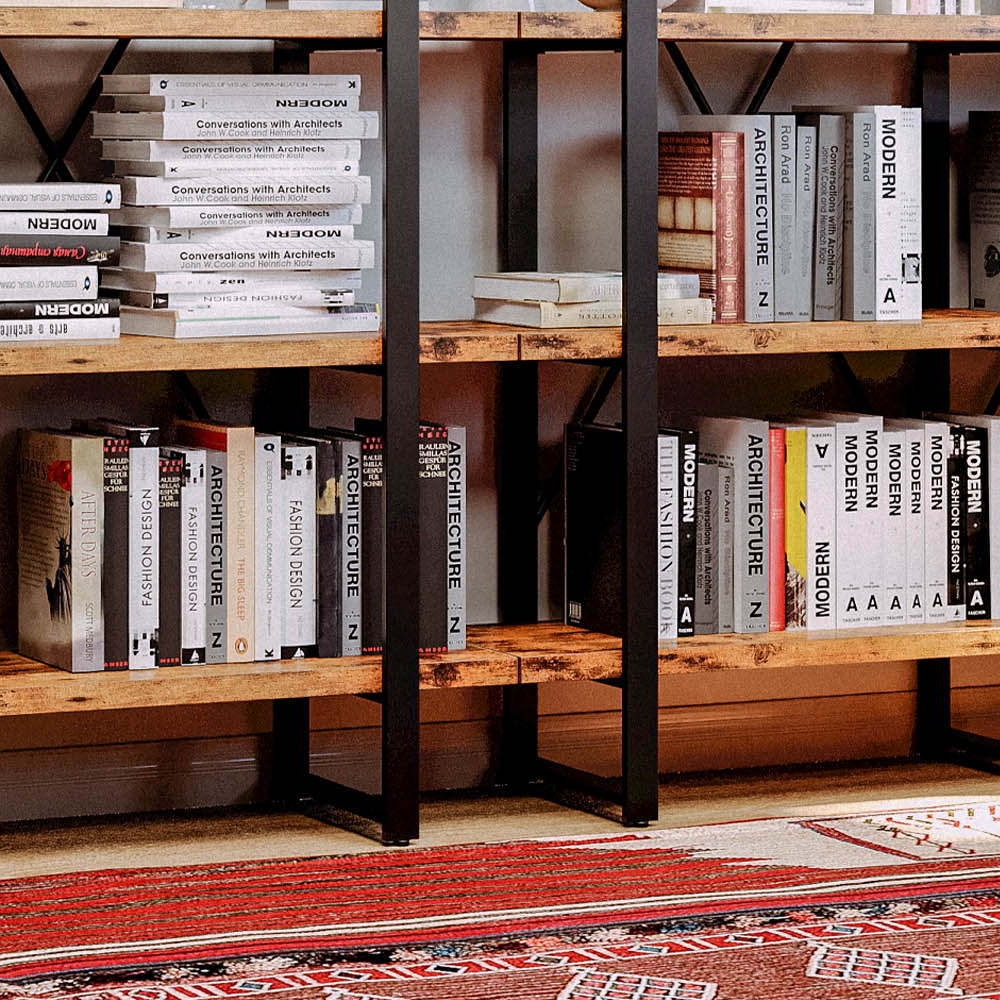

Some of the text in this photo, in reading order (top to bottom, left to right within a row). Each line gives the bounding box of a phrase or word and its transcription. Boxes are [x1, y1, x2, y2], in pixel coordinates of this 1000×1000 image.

[197, 120, 342, 129] Conversations with Architects
[197, 129, 216, 137] John
[250, 129, 266, 137] and
[276, 100, 348, 108] MODERN
[781, 125, 792, 184] Ron Arad
[863, 123, 871, 182] Ron Arad
[882, 119, 896, 199] MODERN
[28, 218, 97, 230] MODERN
[172, 185, 331, 195] Conversations with Architects
[754, 128, 768, 266] ARCHITECTURE
[180, 250, 336, 261] Conversations with Architects
[266, 230, 341, 238] MODERN
[35, 304, 109, 316] MODERN
[759, 292, 768, 307] Z
[883, 287, 896, 303] A
[683, 444, 696, 523] MODERN
[748, 435, 763, 576] ARCHITECTURE
[845, 436, 857, 512] MODERN
[866, 430, 878, 509] MODERN
[889, 444, 901, 516] MODERN
[912, 442, 921, 513] MODERN
[931, 436, 942, 510] MODERN
[967, 440, 982, 513] MODERN
[141, 489, 152, 606] FASHION DESIGN
[210, 465, 223, 606] ARCHITECTURE
[347, 455, 359, 598] ARCHITECTURE
[449, 441, 462, 589] ARCHITECTURE
[951, 476, 959, 573] FASHION DESIGN
[188, 506, 197, 612] FASHION DESIGN
[290, 500, 302, 608] FASHION DESIGN
[816, 542, 830, 617] MODERN
[750, 602, 762, 618] Z
